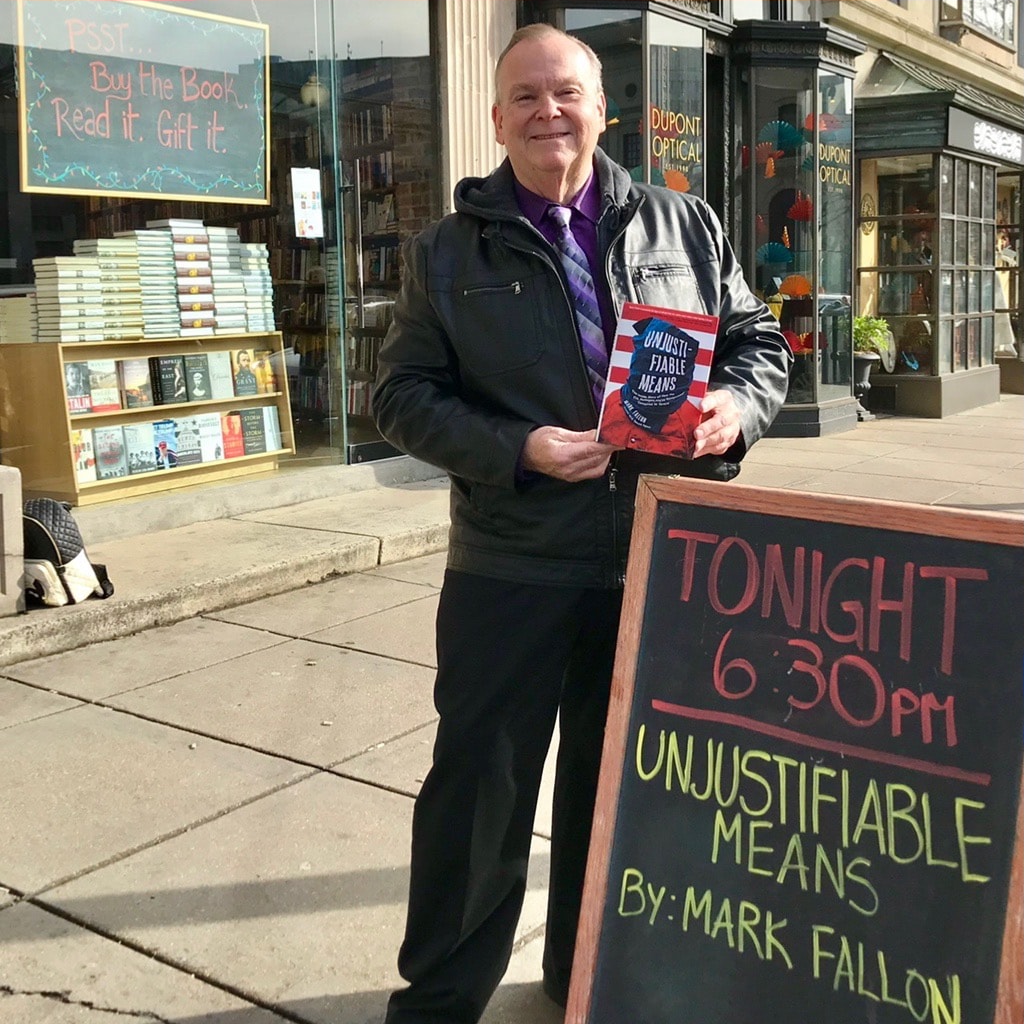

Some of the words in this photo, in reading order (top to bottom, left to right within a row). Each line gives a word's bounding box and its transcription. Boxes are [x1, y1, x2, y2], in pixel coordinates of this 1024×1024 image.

[90, 61, 132, 100] Buy
[138, 61, 174, 100] the
[180, 67, 249, 109] Book.
[51, 97, 111, 141] Read
[122, 102, 144, 142] it.
[157, 109, 200, 151] Gift
[207, 111, 227, 153] it.
[651, 108, 701, 135] DUPONT
[651, 136, 701, 163] OPTICAL
[818, 144, 851, 164] DUPONT
[818, 165, 851, 186] OPTICAL
[643, 330, 693, 358] UNJUSTI-
[649, 354, 686, 376] FIABLE
[638, 374, 677, 394] MEANS
[667, 529, 989, 674] TONIGHT
[635, 724, 991, 883] UNJUSTIFIABLE
[711, 810, 879, 916] MEANS
[683, 886, 793, 969] MARK
[812, 925, 961, 1024] FALLON
